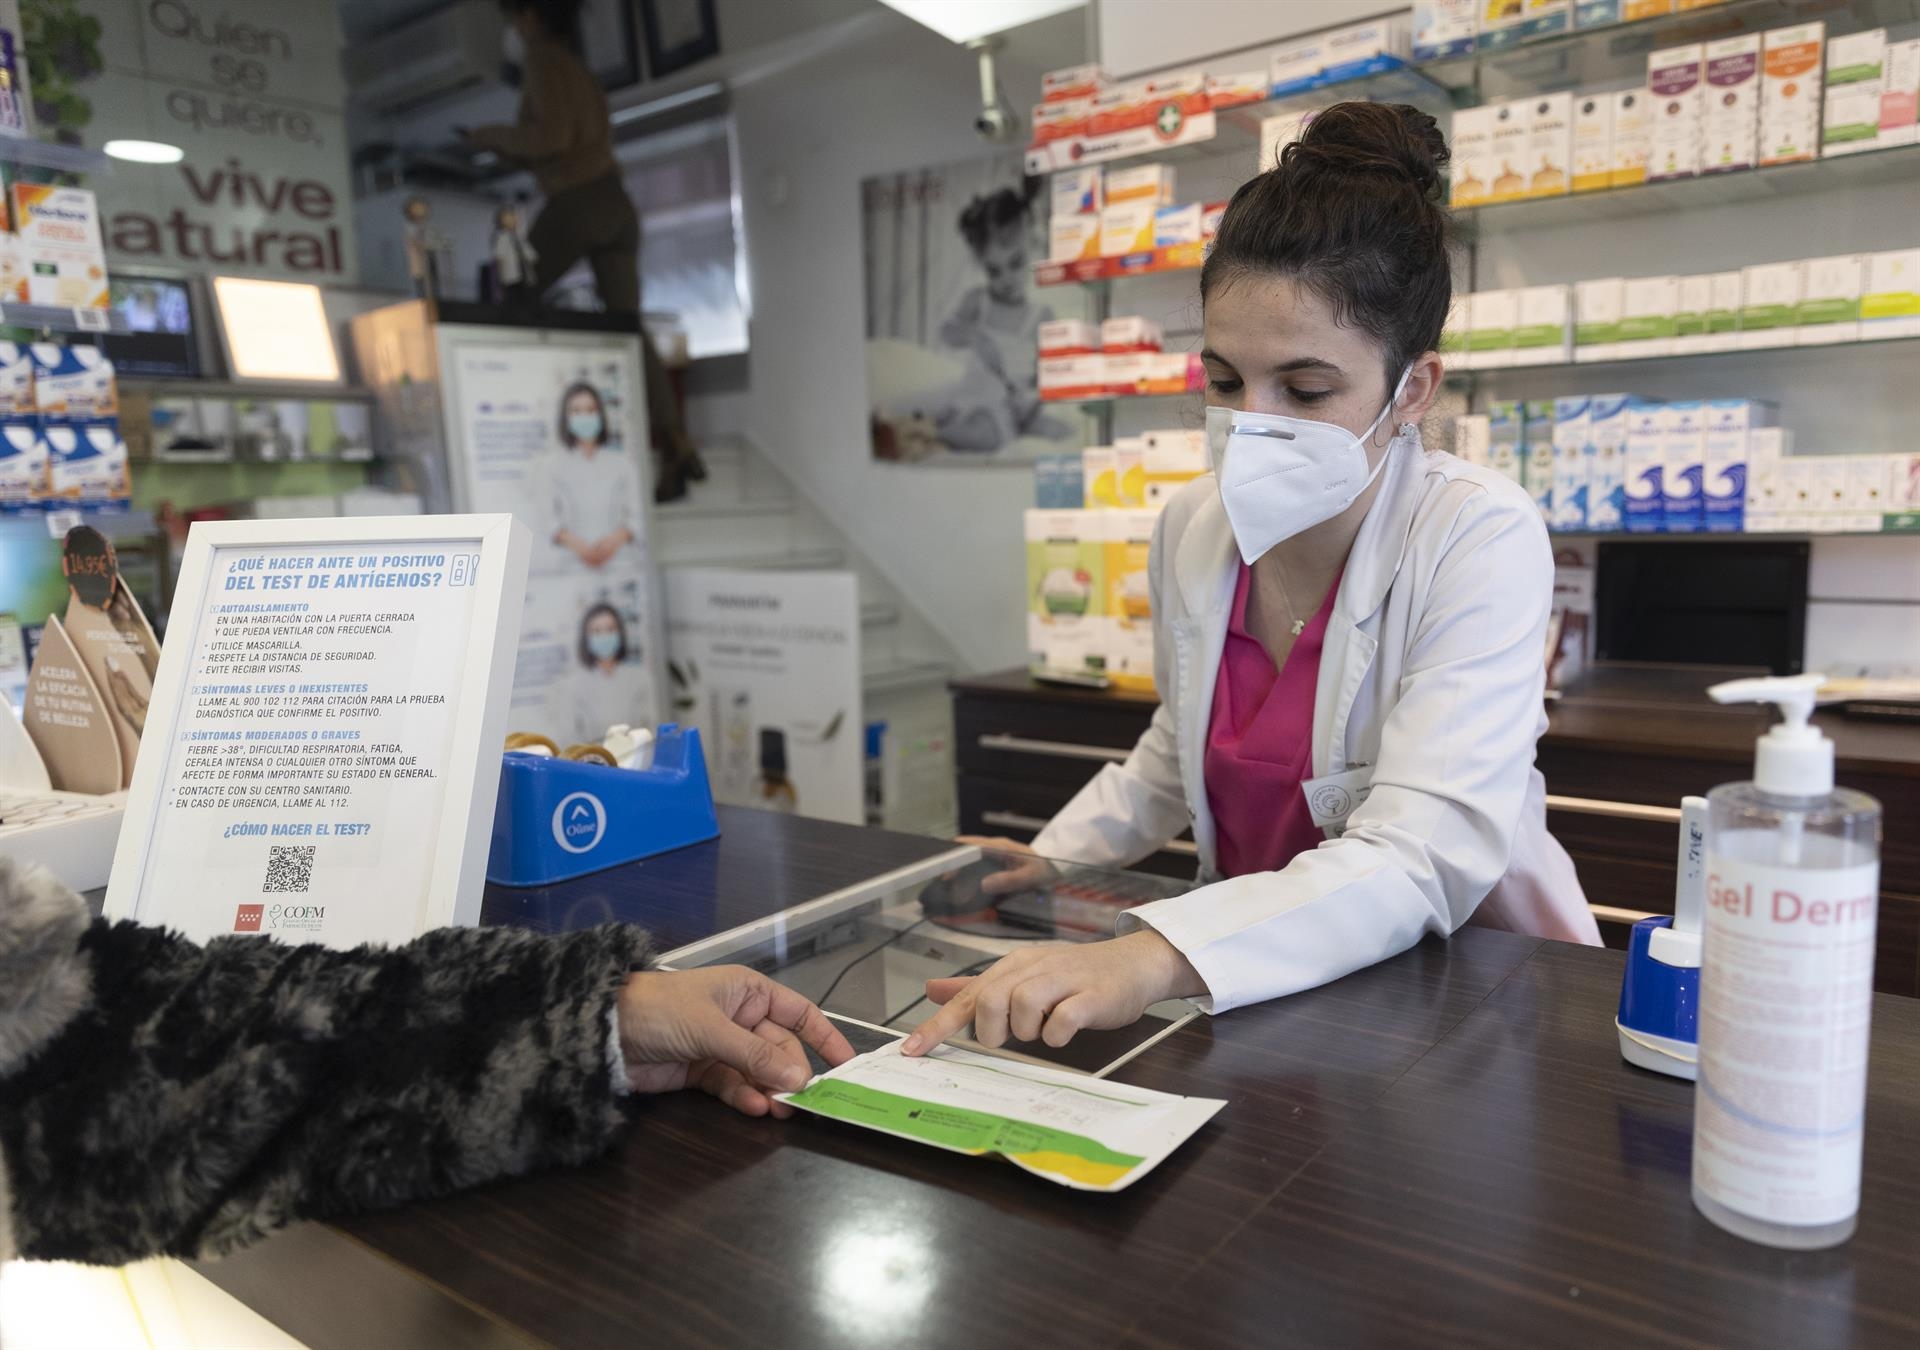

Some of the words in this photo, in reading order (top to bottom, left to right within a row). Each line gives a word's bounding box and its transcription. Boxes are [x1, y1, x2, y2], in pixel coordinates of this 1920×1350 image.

[209, 53, 270, 92] se
[180, 157, 336, 220] vive
[103, 208, 342, 275] atural
[229, 555, 264, 573] ¿QUÉ
[268, 557, 314, 570] HACER
[318, 556, 354, 569] ANTE
[358, 556, 377, 568] UN
[382, 555, 445, 567] POSITIVO
[225, 575, 256, 591] DEL
[262, 574, 303, 590] TEST
[307, 574, 330, 589] DE
[334, 570, 443, 588] ANTÍGENOS?
[220, 603, 310, 613] AUTOAISLAMIENTO
[217, 616, 229, 625] EN
[231, 616, 248, 625] UNA
[251, 613, 302, 624] HABITACIÓN
[304, 614, 322, 623] CON
[325, 614, 336, 622] LA
[339, 614, 372, 622] PUERTA
[374, 613, 415, 622] CERRADA
[215, 628, 220, 637] Y
[222, 628, 239, 637] QUE
[242, 627, 270, 636] PUEDA
[273, 627, 313, 636] VENTILAR
[316, 626, 334, 635] CON
[337, 625, 393, 634] FRECUENCIA.
[211, 642, 244, 651] UTILICE
[246, 641, 302, 650] MASCARILLA.
[208, 653, 246, 662] RESPETE
[249, 653, 259, 662] LA
[262, 652, 307, 661] DISTANCIA
[310, 652, 322, 661] DE
[324, 652, 376, 661] SEGURIDAD.
[205, 665, 229, 674] EVITE
[232, 665, 266, 674] RECIBIR
[269, 664, 303, 673] VISITAS.
[201, 684, 252, 695] SÍNTOMAS
[255, 684, 286, 694] LEVES
[289, 685, 296, 694] O
[298, 684, 368, 693] INEXISTENTES
[198, 698, 227, 706] LLAME
[229, 697, 240, 706] AL
[243, 697, 260, 706] 900
[263, 697, 279, 705] 102
[283, 697, 299, 705] 112
[301, 696, 324, 705] PARA
[327, 694, 368, 705] CITACIÓN
[370, 696, 393, 704] PARA
[395, 695, 407, 704] LA
[409, 695, 445, 704] PRUEBA
[196, 707, 253, 718] DIAGNÓSTICA
[256, 709, 274, 718] QUE
[277, 708, 323, 717] CONFIRME
[326, 708, 336, 717] EL
[339, 707, 381, 717] POSITIVO.
[191, 729, 242, 741] SÍNTOMAS
[245, 730, 308, 740] MODERADOS
[311, 731, 318, 739] O
[321, 730, 360, 739] GRAVES
[188, 745, 219, 754] FIEBRE
[249, 745, 299, 754] DIFICULTAD
[302, 744, 367, 754] RESPIRATORIA,
[371, 744, 403, 754] FATIGA,
[185, 758, 222, 767] CEFALEA
[225, 758, 263, 767] INTENSA
[266, 758, 273, 766] O
[276, 757, 326, 766] CUALQUIER
[328, 757, 352, 766] OTRO
[356, 755, 396, 766] SÍNTOMA
[399, 756, 417, 766] QUE
[181, 770, 215, 780] AFECTE
[218, 770, 230, 779] DE
[232, 770, 264, 779] FORMA
[267, 769, 324, 779] IMPORTANTE
[327, 769, 339, 779] SU
[341, 769, 376, 778] ESTADO
[379, 769, 391, 778] EN
[394, 769, 437, 778] GENERAL.
[179, 786, 225, 795] CONTACTE
[228, 786, 247, 795] CON
[250, 786, 261, 795] SU
[264, 786, 300, 795] CENTRO
[303, 786, 352, 795] SANITARIO.
[176, 799, 188, 808] EN
[190, 799, 215, 808] CASO
[217, 799, 230, 808] DE
[232, 799, 280, 808] URGENCIA,
[283, 798, 313, 808] LLAME
[315, 799, 326, 808] AL
[330, 798, 349, 808] 112.
[223, 821, 268, 838] ¿CÓMO
[270, 824, 312, 835] HACER
[315, 824, 330, 835] EL
[334, 823, 371, 835] TEST?
[1706, 873, 1753, 917] Gel
[283, 906, 326, 919] COFM
